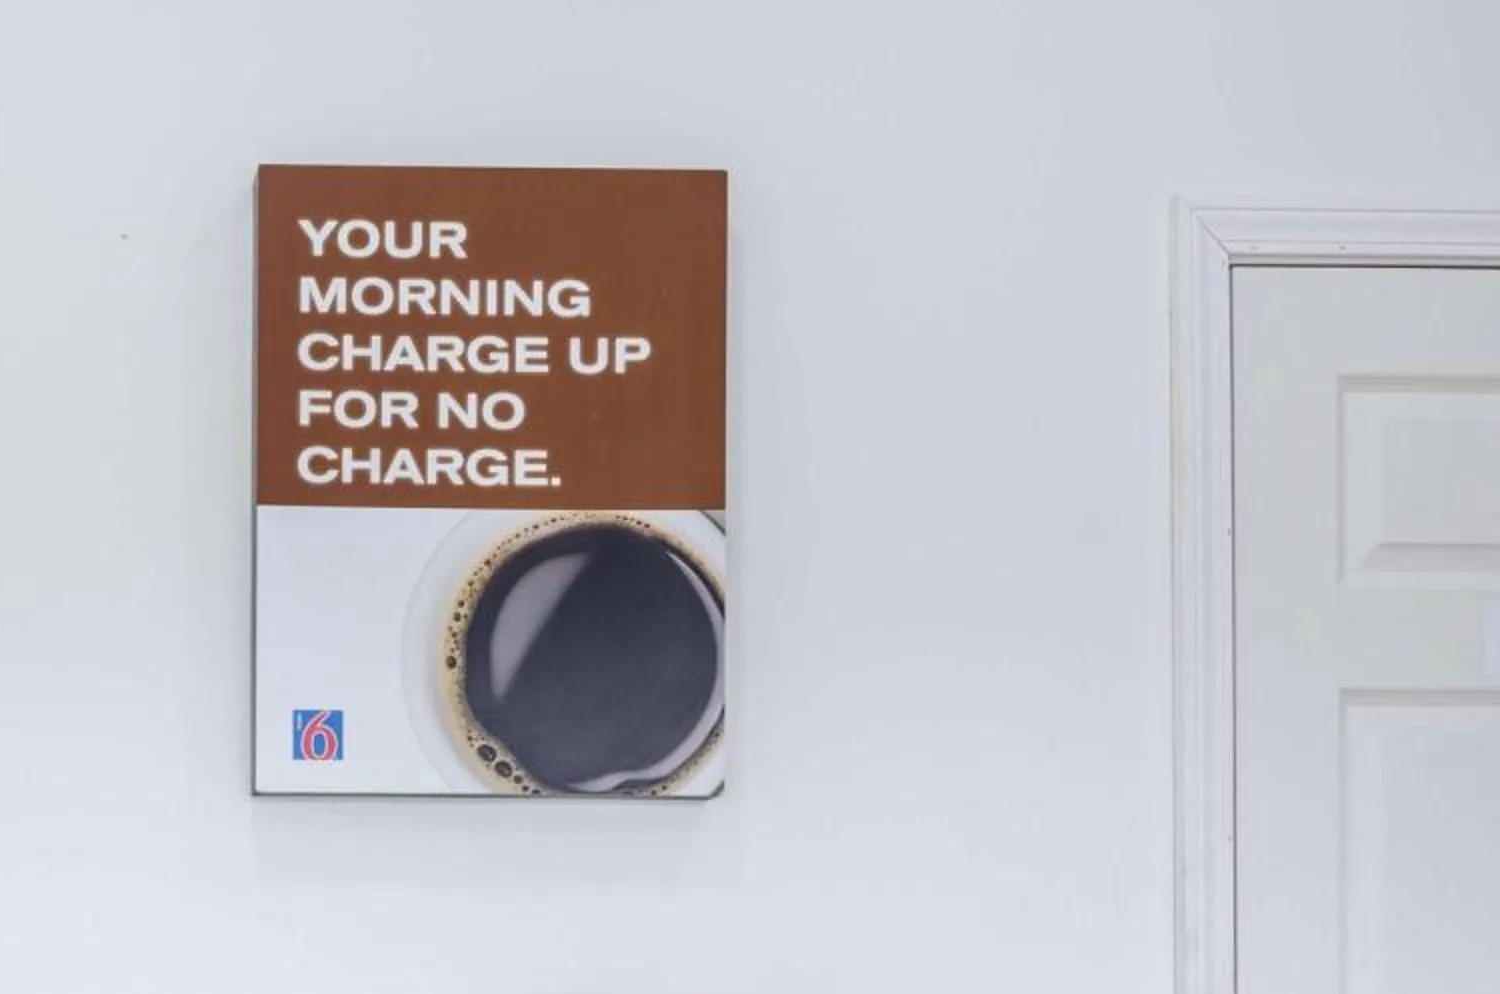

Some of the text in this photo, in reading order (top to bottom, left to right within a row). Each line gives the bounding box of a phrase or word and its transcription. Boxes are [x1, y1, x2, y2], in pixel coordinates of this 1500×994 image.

[298, 219, 468, 259] YOUR
[299, 277, 591, 317] MORNING
[297, 333, 651, 375] CHARGE UP
[298, 390, 525, 431] FOR NO
[297, 446, 561, 486] CHARGE.
[301, 708, 338, 761] 6
